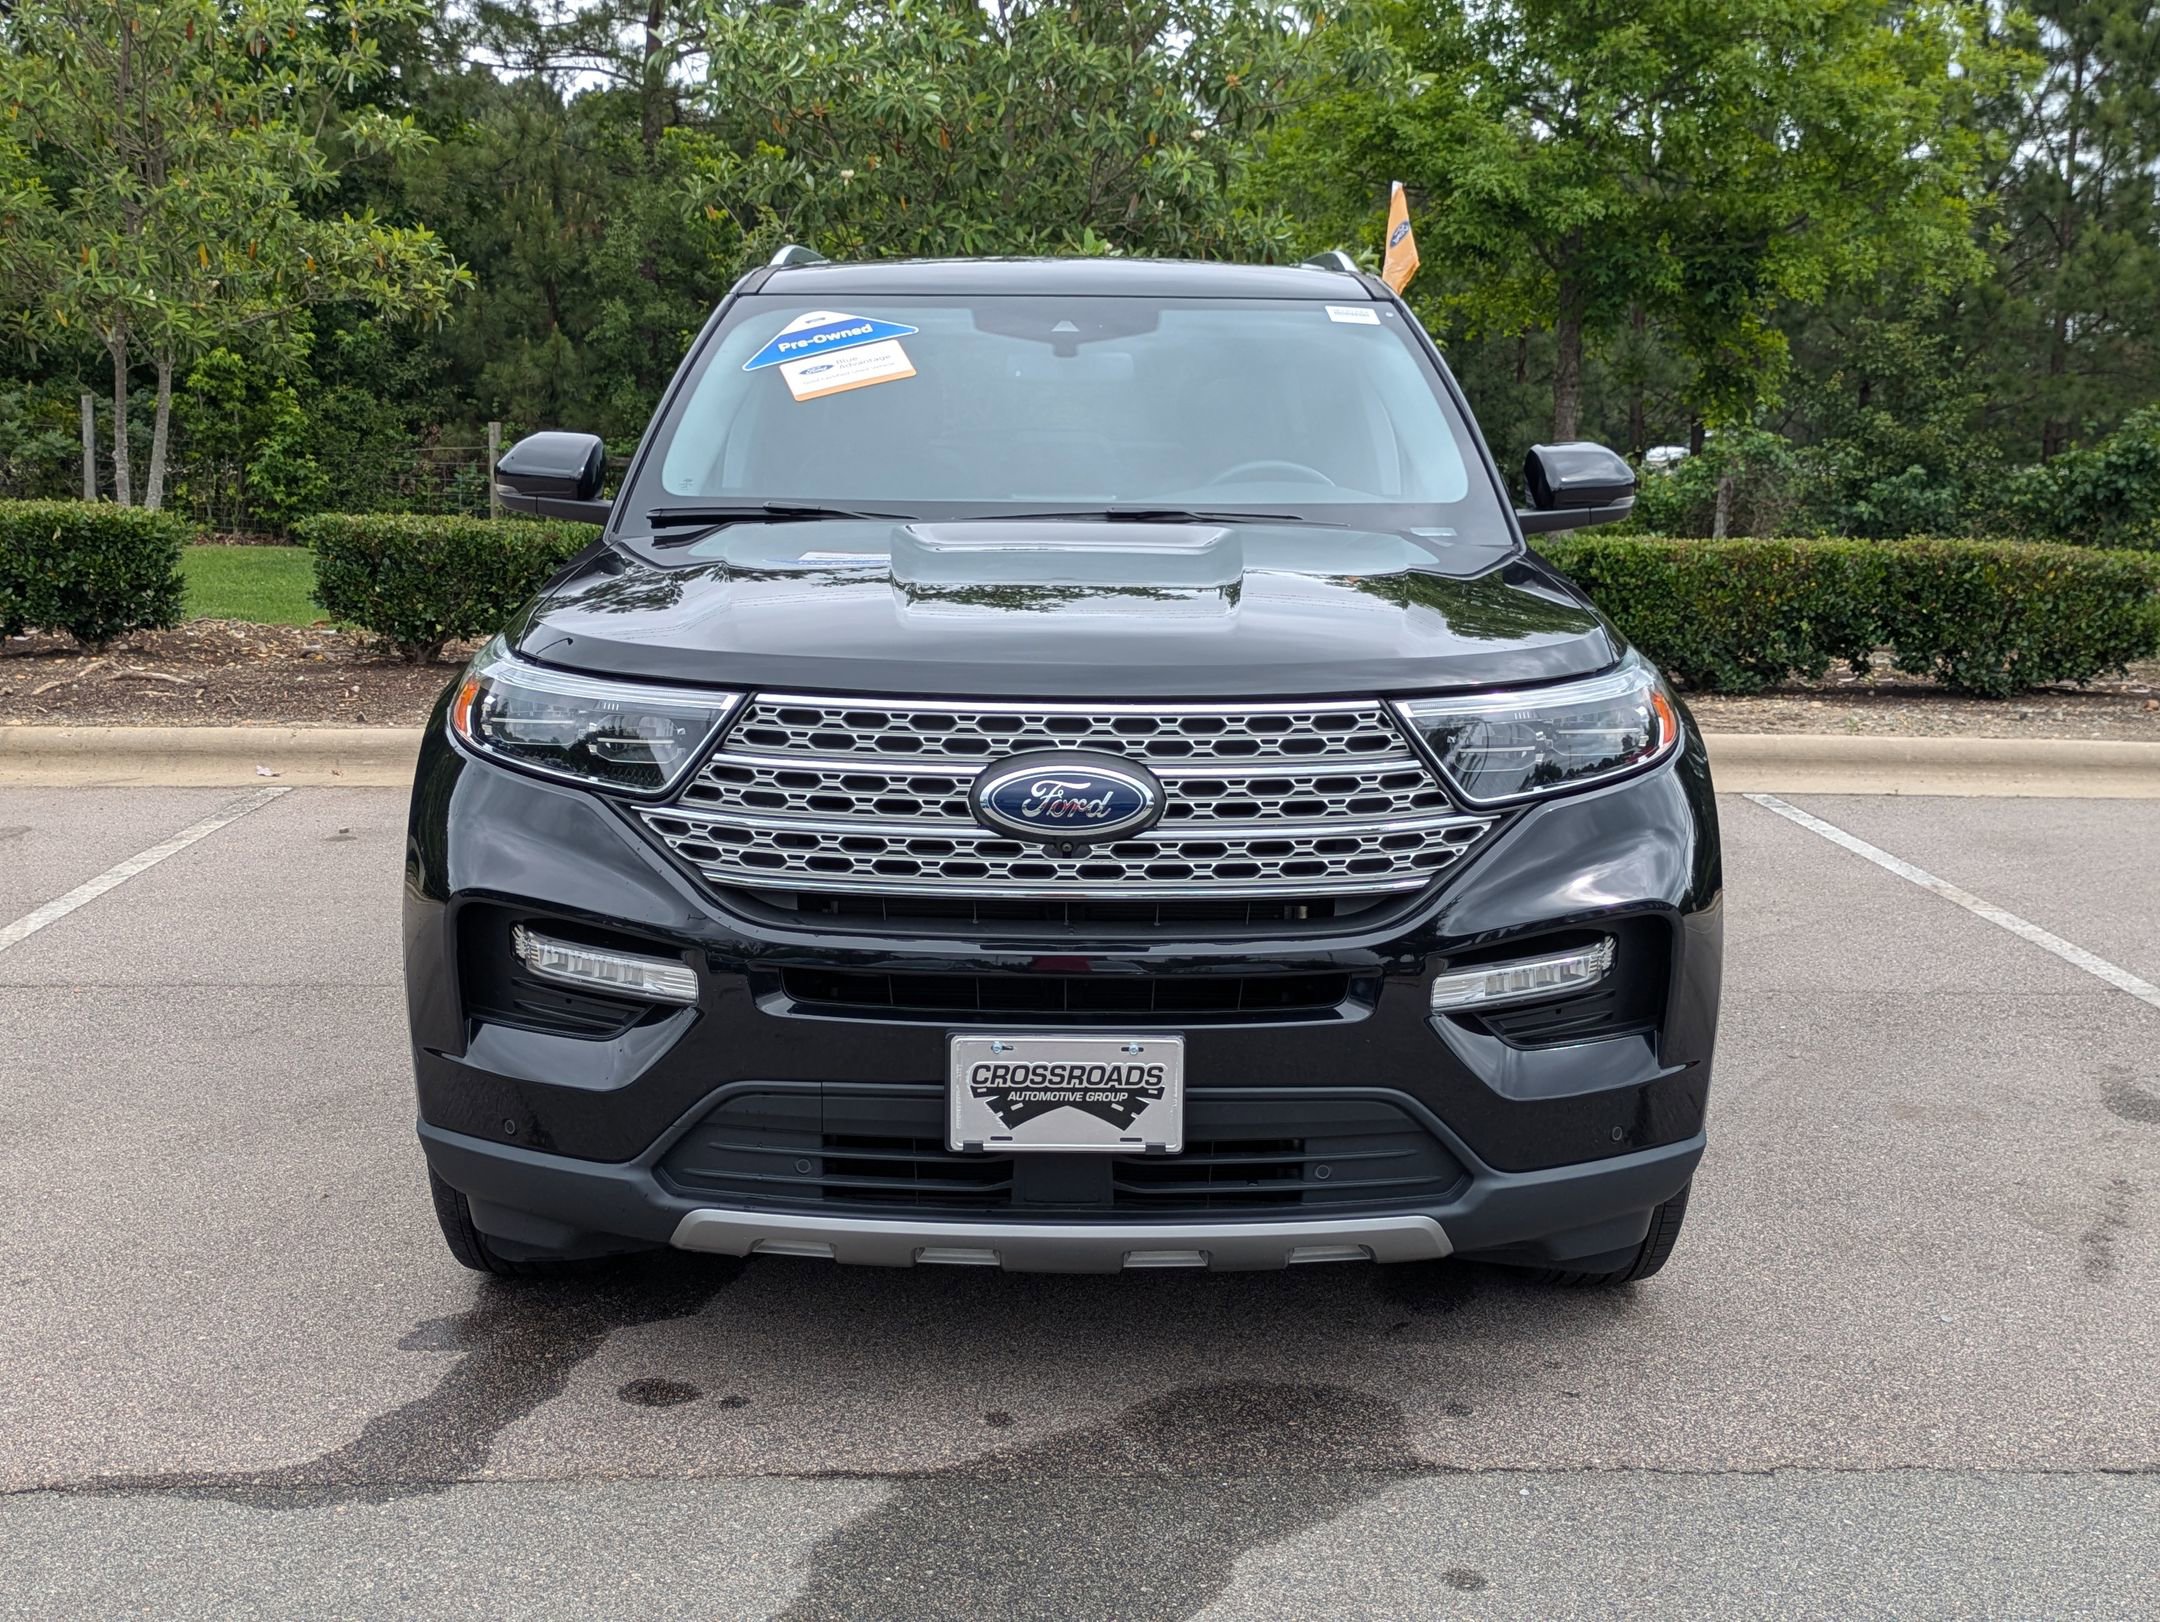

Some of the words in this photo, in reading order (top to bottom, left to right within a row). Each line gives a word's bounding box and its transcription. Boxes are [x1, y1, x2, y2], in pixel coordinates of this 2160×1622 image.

[778, 323, 873, 352] Pre-Owned
[1021, 780, 1113, 818] Ford
[971, 1064, 1164, 1088] CROSSROADS
[1007, 1091, 1083, 1102] AUTOMOTIVE
[1086, 1092, 1129, 1103] GROUP
